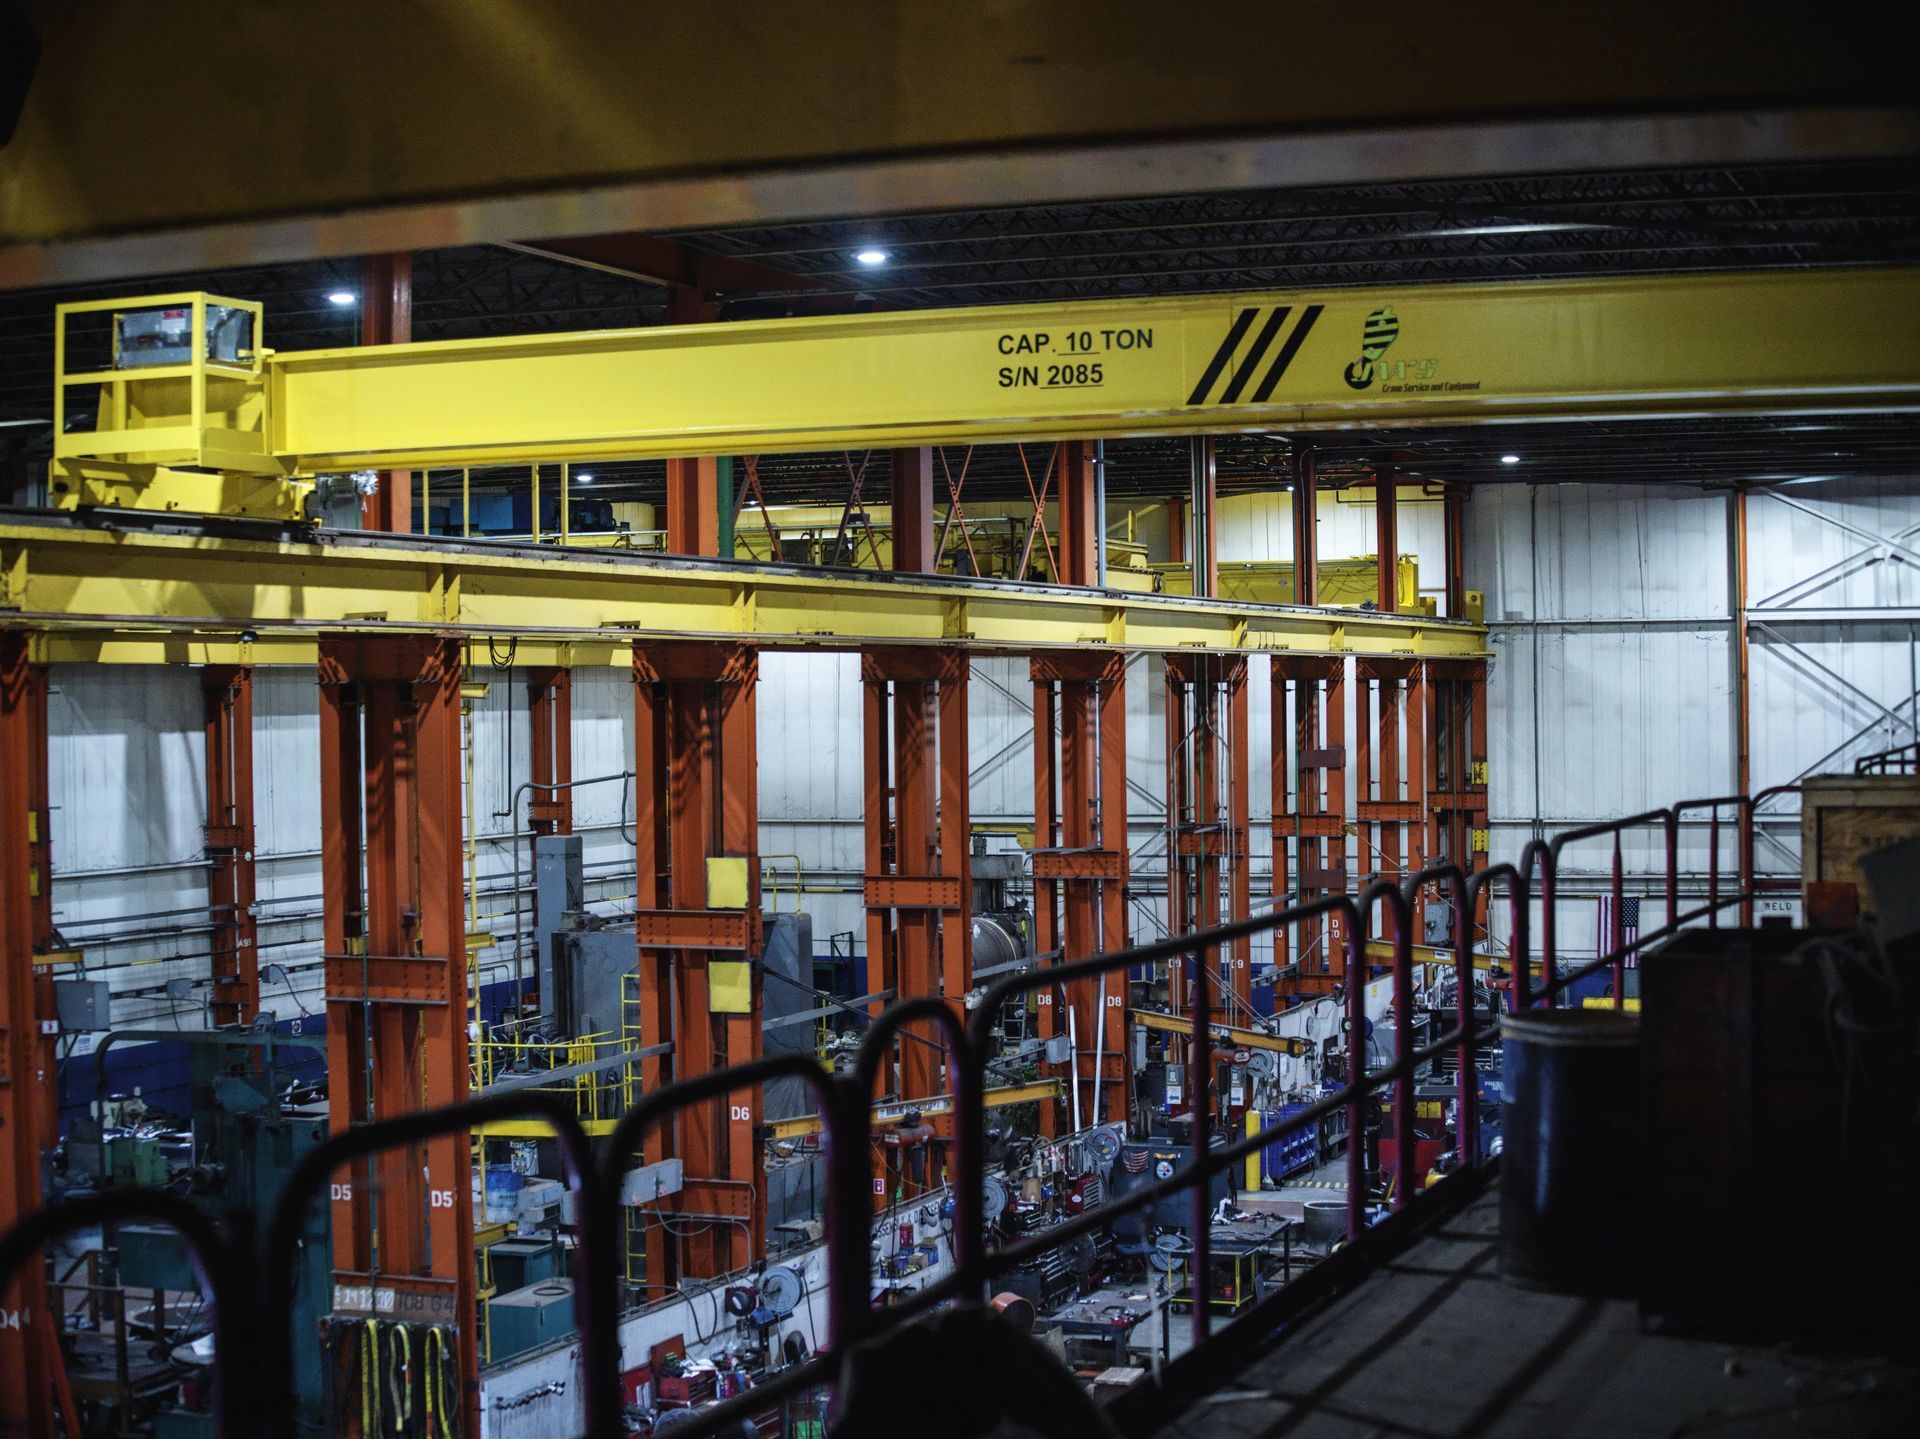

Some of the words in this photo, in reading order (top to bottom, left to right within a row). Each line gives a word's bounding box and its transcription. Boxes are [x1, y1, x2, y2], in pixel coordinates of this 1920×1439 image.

[998, 333, 1056, 355] CAP.
[1066, 331, 1093, 352] 10
[1100, 328, 1153, 350] TON
[998, 366, 1038, 388] S/N
[1047, 363, 1104, 386] 2085
[1403, 382, 1430, 393] Service
[1763, 902, 1793, 911] WELD
[1037, 994, 1052, 1005] D8
[1107, 996, 1122, 1007] D8
[731, 1105, 750, 1121] D6
[330, 1184, 352, 1201] D5
[431, 1190, 453, 1208] D5
